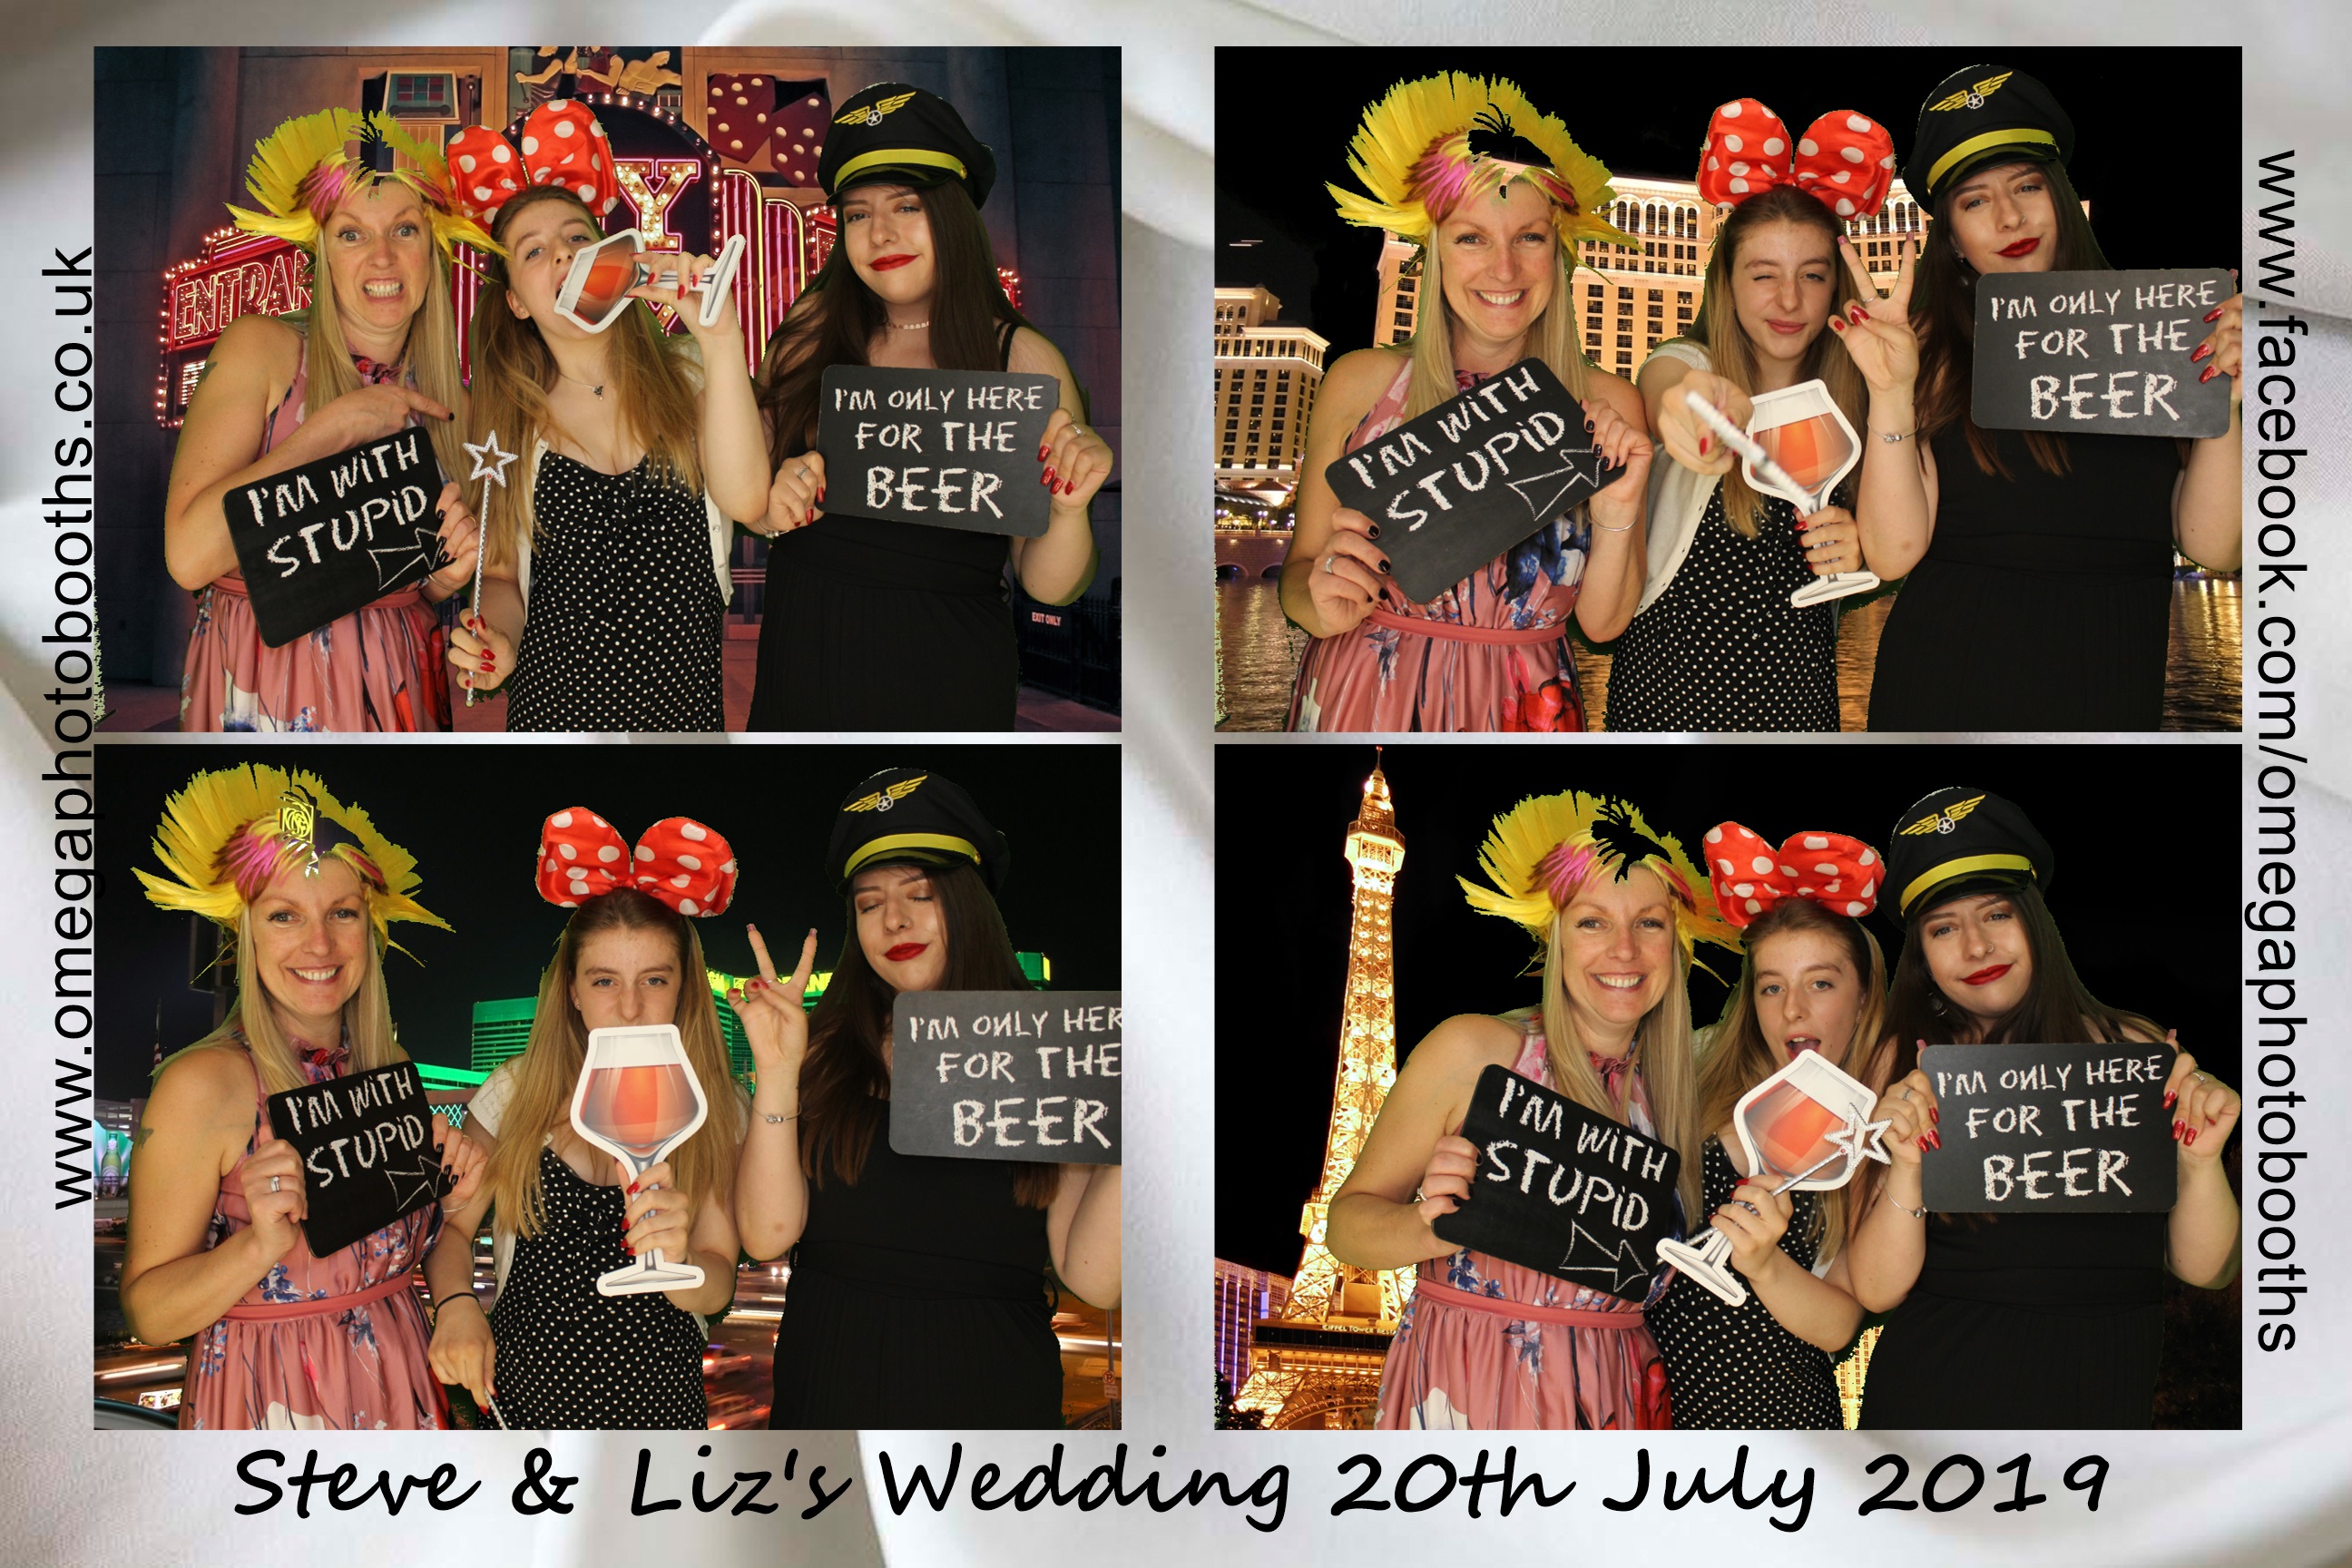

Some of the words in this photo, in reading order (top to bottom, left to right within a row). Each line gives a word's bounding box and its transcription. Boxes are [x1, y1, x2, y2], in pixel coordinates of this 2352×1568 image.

[1991, 295, 2038, 322] I'M
[2049, 288, 2122, 317] ONLY
[2134, 279, 2218, 310] HERE
[2014, 328, 2091, 360] FOR
[2107, 318, 2191, 355] THE
[835, 387, 877, 412] I'M
[887, 387, 956, 414] ONLY
[967, 385, 1044, 412] HERE
[2030, 371, 2180, 421] BEER
[855, 421, 923, 454] FOR
[941, 421, 1018, 453] THE
[1348, 431, 1433, 490] I'M
[247, 472, 319, 527] I'M
[867, 466, 1004, 519] BEER
[909, 1015, 960, 1044] I'M
[972, 1009, 1049, 1040] ONLY
[935, 1050, 1016, 1084] FOR
[1035, 1043, 1122, 1080] THE
[1936, 1070, 1987, 1099] I'M
[1999, 1063, 2073, 1092] ONLY
[2085, 1054, 2163, 1085] HERE
[286, 1089, 342, 1135] I'M
[952, 1095, 1112, 1150] BEER
[1499, 1077, 1563, 1140] I'M
[1965, 1104, 2043, 1140] FOR
[2061, 1093, 2141, 1132] THE
[1983, 1147, 2133, 1202] BEER
